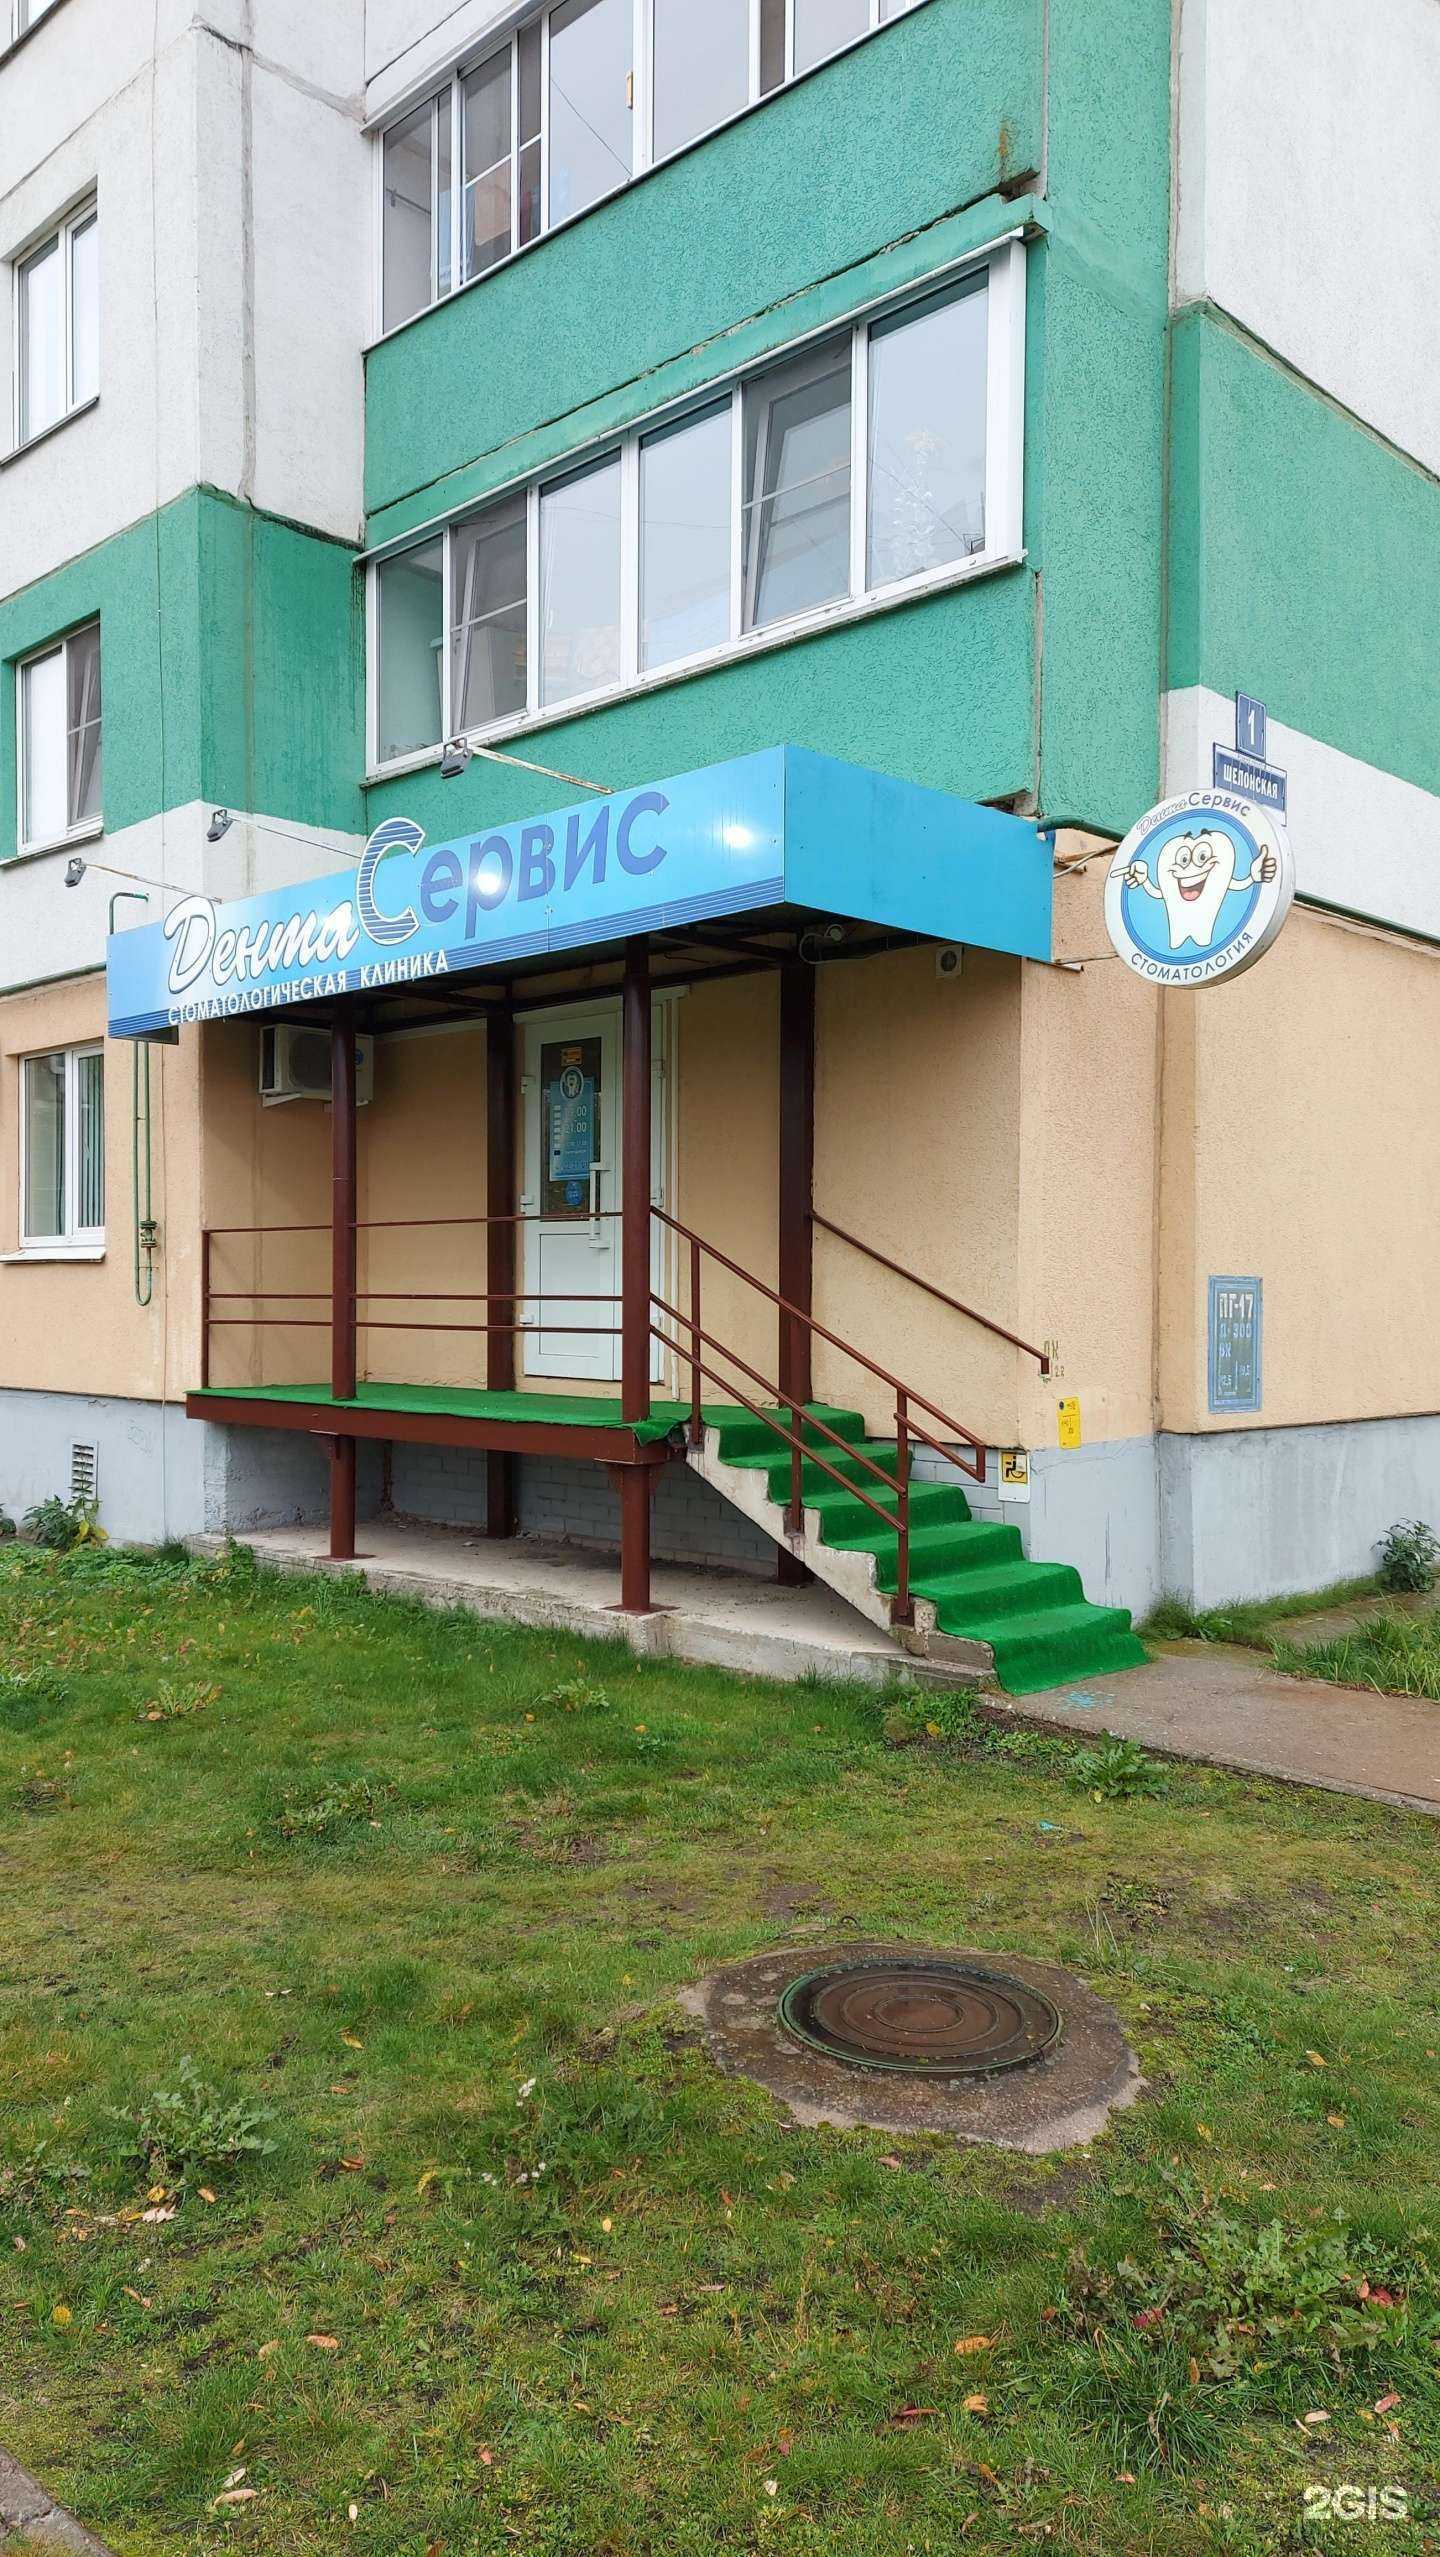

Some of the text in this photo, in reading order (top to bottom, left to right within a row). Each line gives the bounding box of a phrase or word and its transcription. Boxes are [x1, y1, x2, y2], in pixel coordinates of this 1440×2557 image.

[1247, 709, 1256, 746] 1
[1222, 762, 1279, 800] ШЕЛОНСКАЯ
[1130, 931, 1254, 982] СТОМАТОЛОГИЯ
[168, 948, 450, 1027] СТОМАТОЛОГИЧЕСКАЯ КЛИНИКА
[1219, 1292, 1254, 1319] ПГ-17
